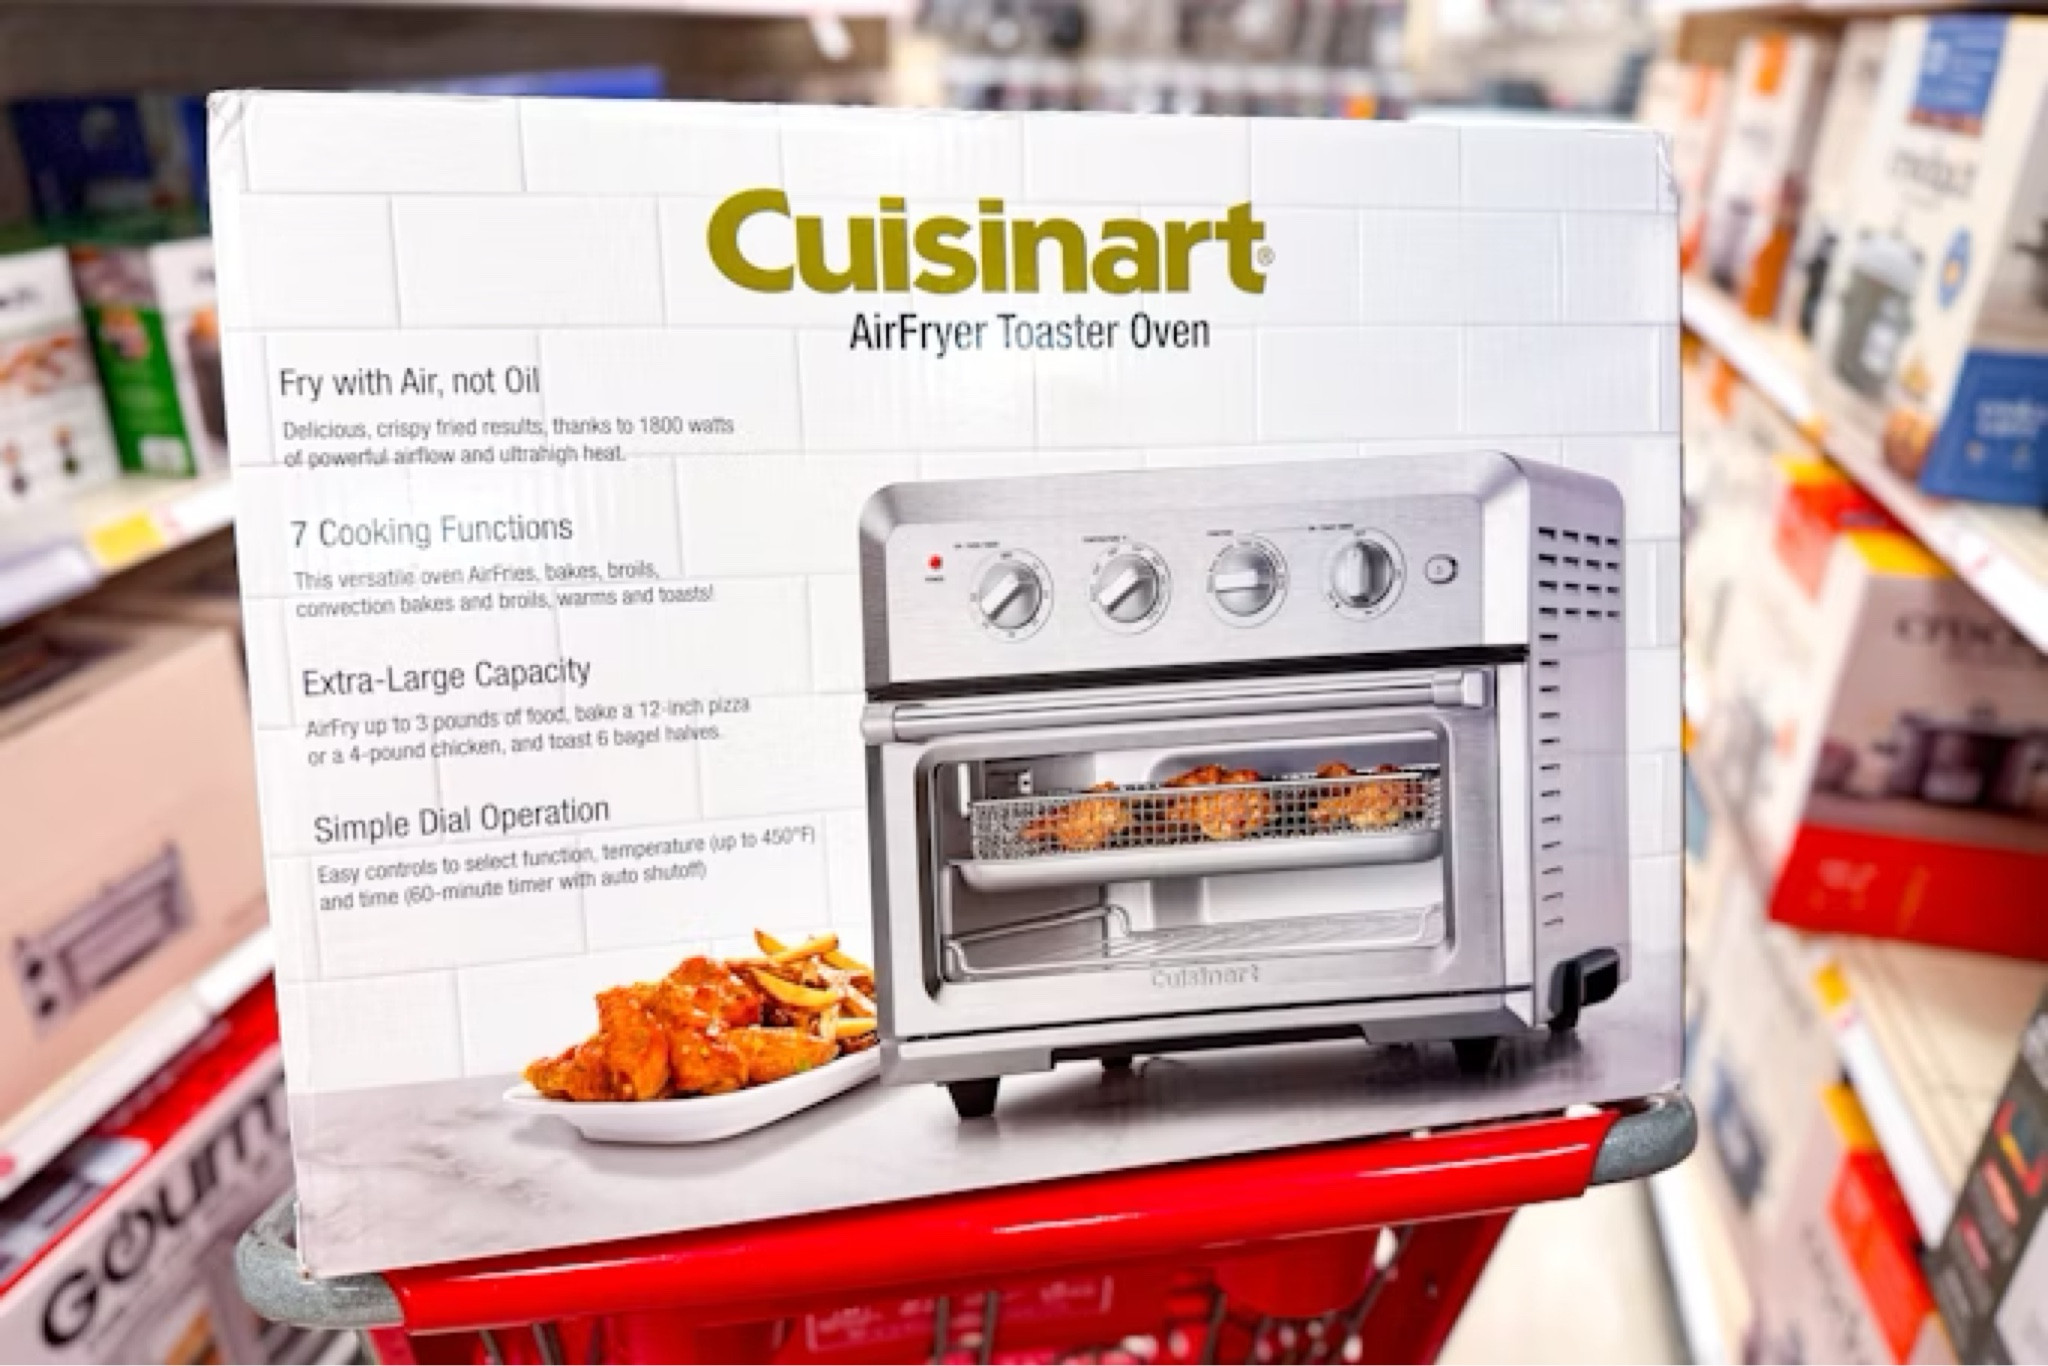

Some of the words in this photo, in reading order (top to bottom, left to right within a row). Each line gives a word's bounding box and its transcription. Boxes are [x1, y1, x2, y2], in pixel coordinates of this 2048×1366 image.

[849, 313, 988, 359] AirFryer
[996, 313, 1121, 350] Toaster
[1130, 312, 1211, 349] Oven
[281, 368, 323, 402] Fry
[332, 368, 393, 396] with
[401, 367, 444, 399] Air,
[452, 368, 497, 394] not
[505, 365, 540, 394] Oil
[376, 419, 432, 440] crispy
[436, 418, 477, 437] fried
[481, 418, 548, 438] results,
[554, 417, 612, 435] thanks
[616, 417, 635, 435] to
[639, 416, 684, 435] 1800
[687, 416, 734, 434] watts
[284, 449, 304, 467] of
[308, 447, 389, 470] powerful
[394, 446, 456, 464] airflow
[461, 446, 495, 464] and
[499, 444, 579, 467] ultrahigh
[290, 520, 308, 549] 7
[319, 517, 432, 551] Cooking
[440, 514, 573, 543] Functions
[293, 572, 334, 590] This
[338, 569, 415, 588] versatile
[421, 570, 465, 584] oven
[296, 598, 396, 618] convection
[400, 596, 456, 614] bakes
[460, 593, 494, 612] and
[558, 591, 618, 606] warms
[622, 587, 654, 605] and
[303, 664, 465, 697] Extra-Large
[475, 658, 590, 691] Capacity
[305, 717, 360, 739] AirFry
[364, 719, 387, 737] up
[391, 716, 411, 734] to
[415, 713, 429, 732] 3
[433, 710, 500, 734] pounds
[505, 707, 522, 727] of
[575, 703, 618, 723] bake
[622, 704, 633, 720] a
[708, 697, 750, 717] pizza
[307, 748, 329, 767] or
[331, 748, 345, 765] a
[349, 743, 426, 767] 4-pound
[511, 734, 543, 753] and
[547, 731, 592, 751] toast
[596, 729, 609, 747] 6
[613, 726, 660, 749] bagel
[314, 811, 411, 845] Simple
[419, 805, 472, 836] Dial
[481, 798, 611, 835] Operation
[316, 865, 360, 886] Easy
[364, 858, 438, 882] controls
[442, 857, 460, 874] to
[465, 851, 518, 873] select
[602, 837, 706, 862] temperature
[709, 834, 738, 854] (up
[741, 832, 759, 849] to
[319, 893, 355, 912] and
[358, 890, 399, 908] time
[404, 880, 504, 907] (60-minute
[508, 876, 556, 896] timer
[559, 871, 598, 890] with
[601, 867, 639, 887] auto
